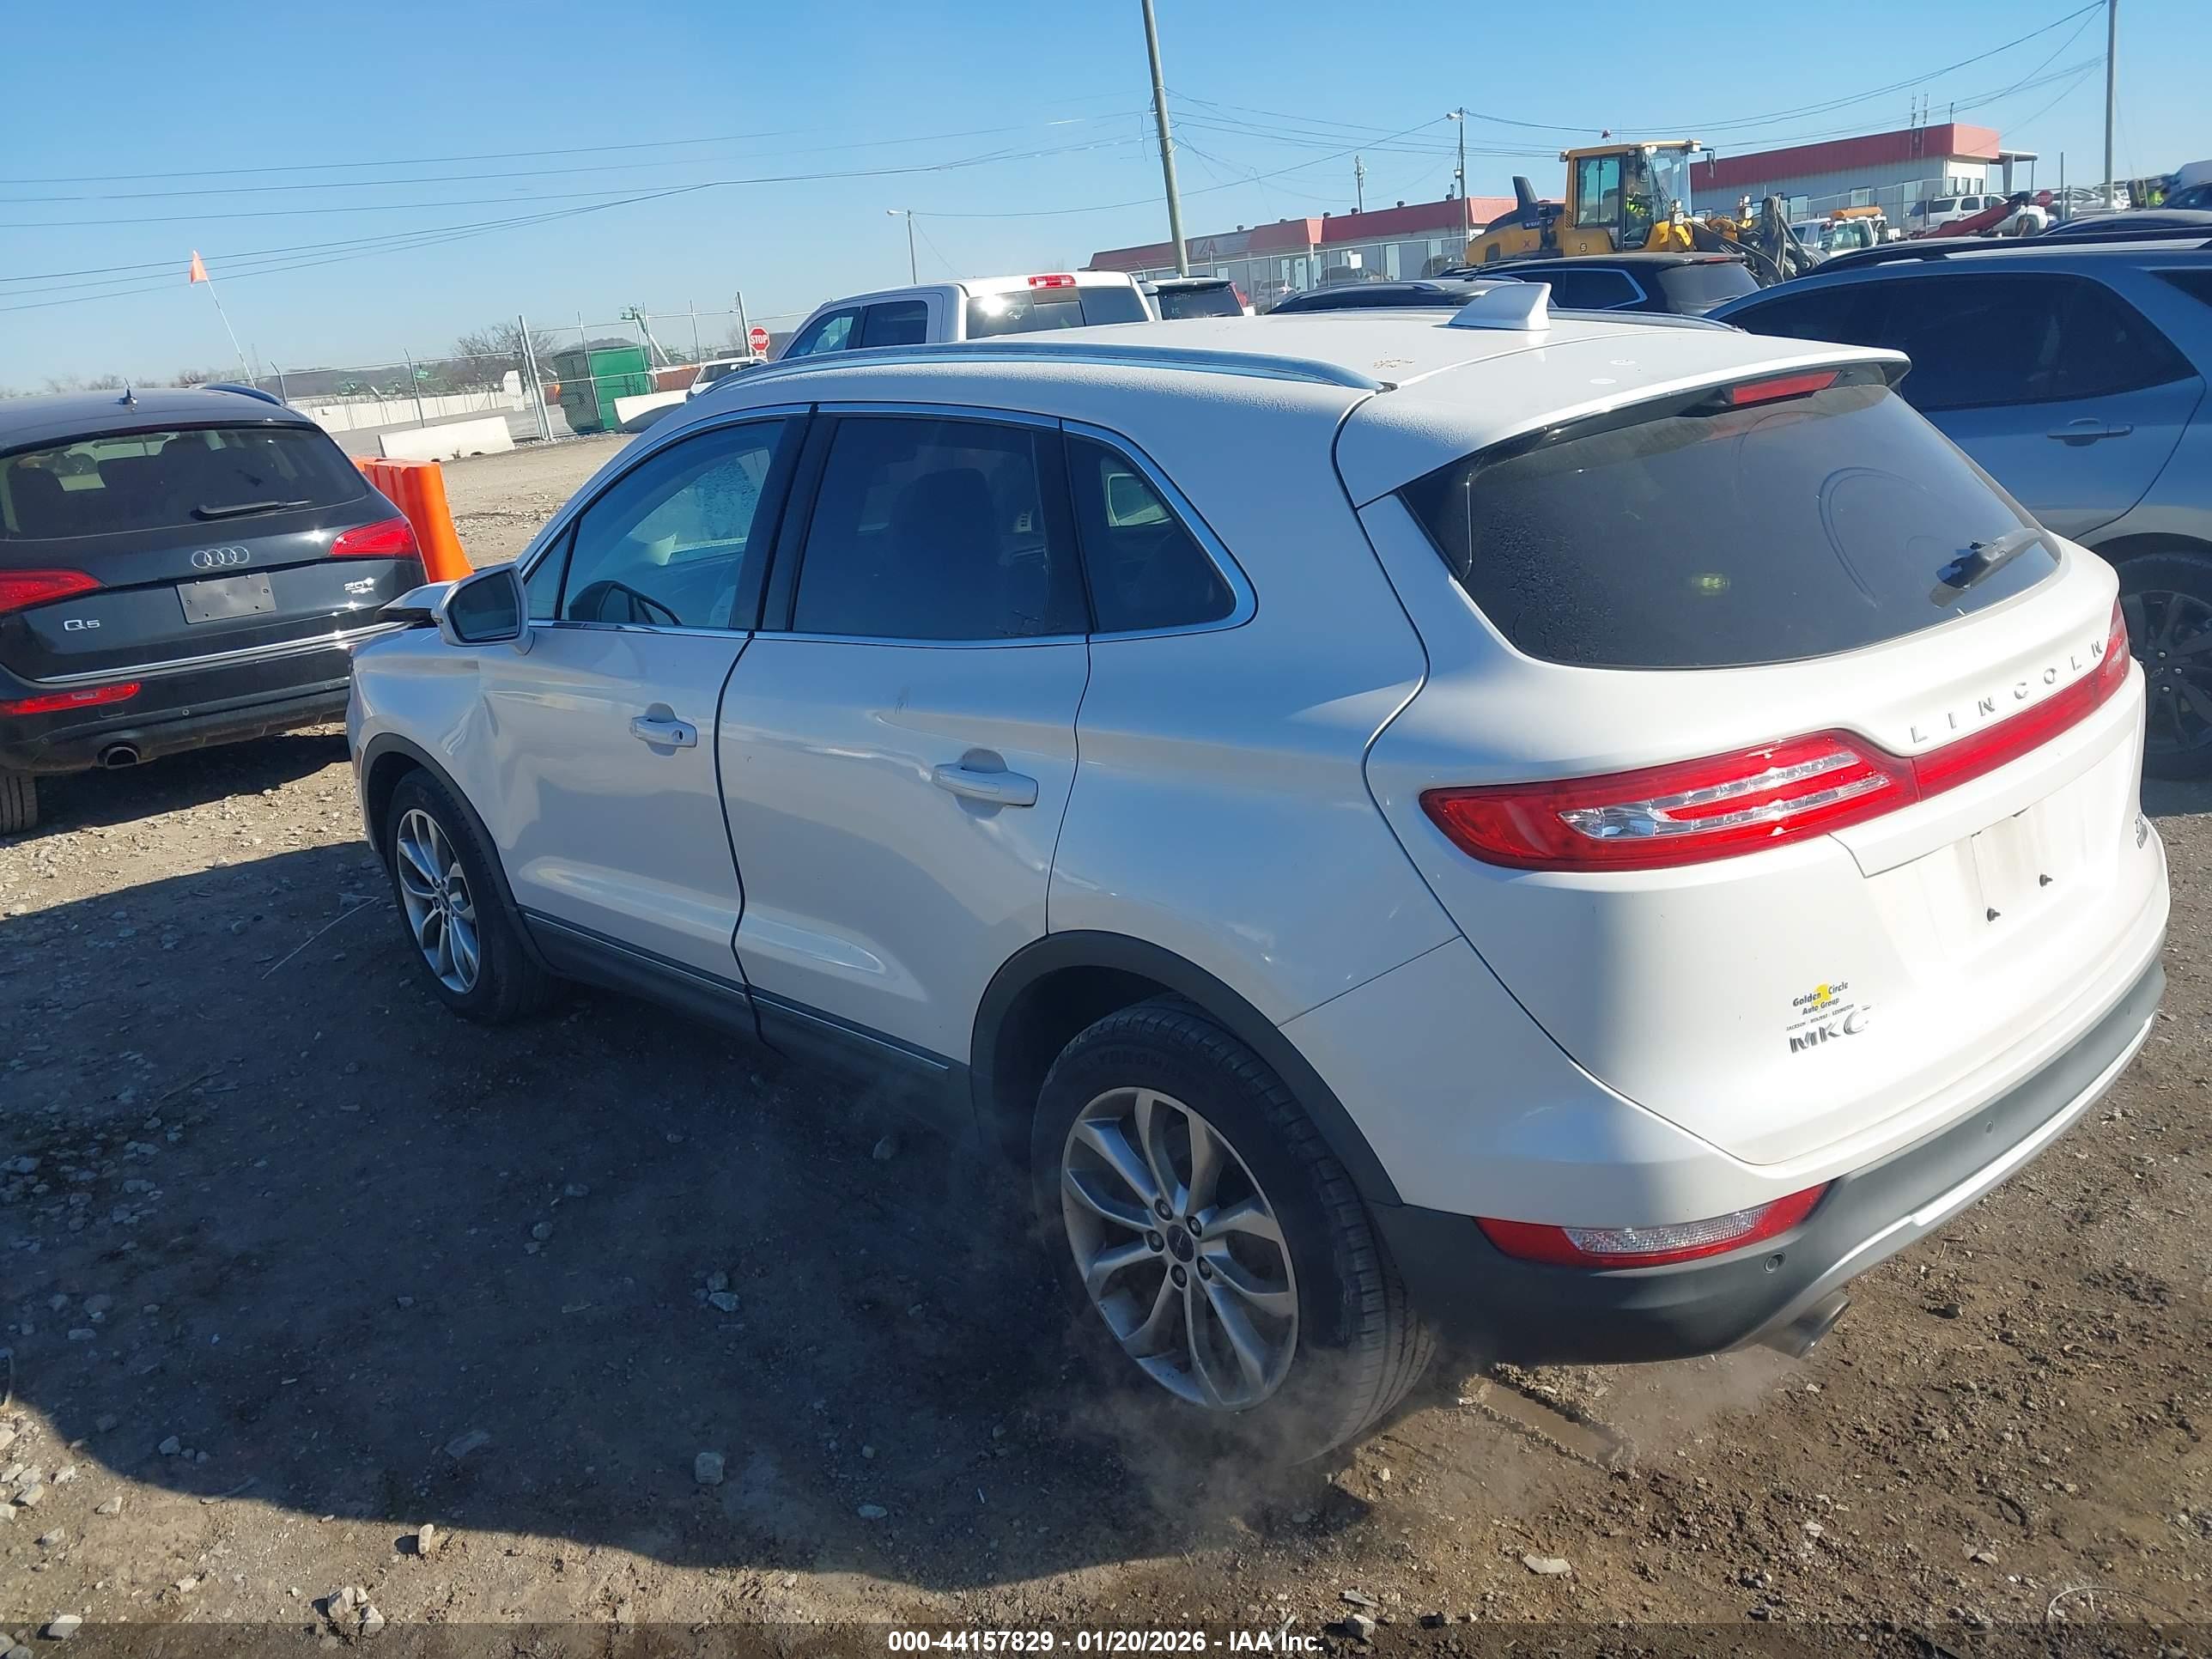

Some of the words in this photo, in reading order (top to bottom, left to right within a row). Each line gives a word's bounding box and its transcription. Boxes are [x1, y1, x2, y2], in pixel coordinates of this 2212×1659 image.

[750, 334, 768, 344] STOP
[64, 619, 100, 631] Q5
[1910, 641, 2104, 744] LINCOLN
[1792, 992, 1821, 1007] Golden
[1828, 981, 1849, 994] Circle
[1802, 1005, 1819, 1016] Auto
[1820, 997, 1840, 1009] Group
[1789, 1004, 1872, 1054] MKC
